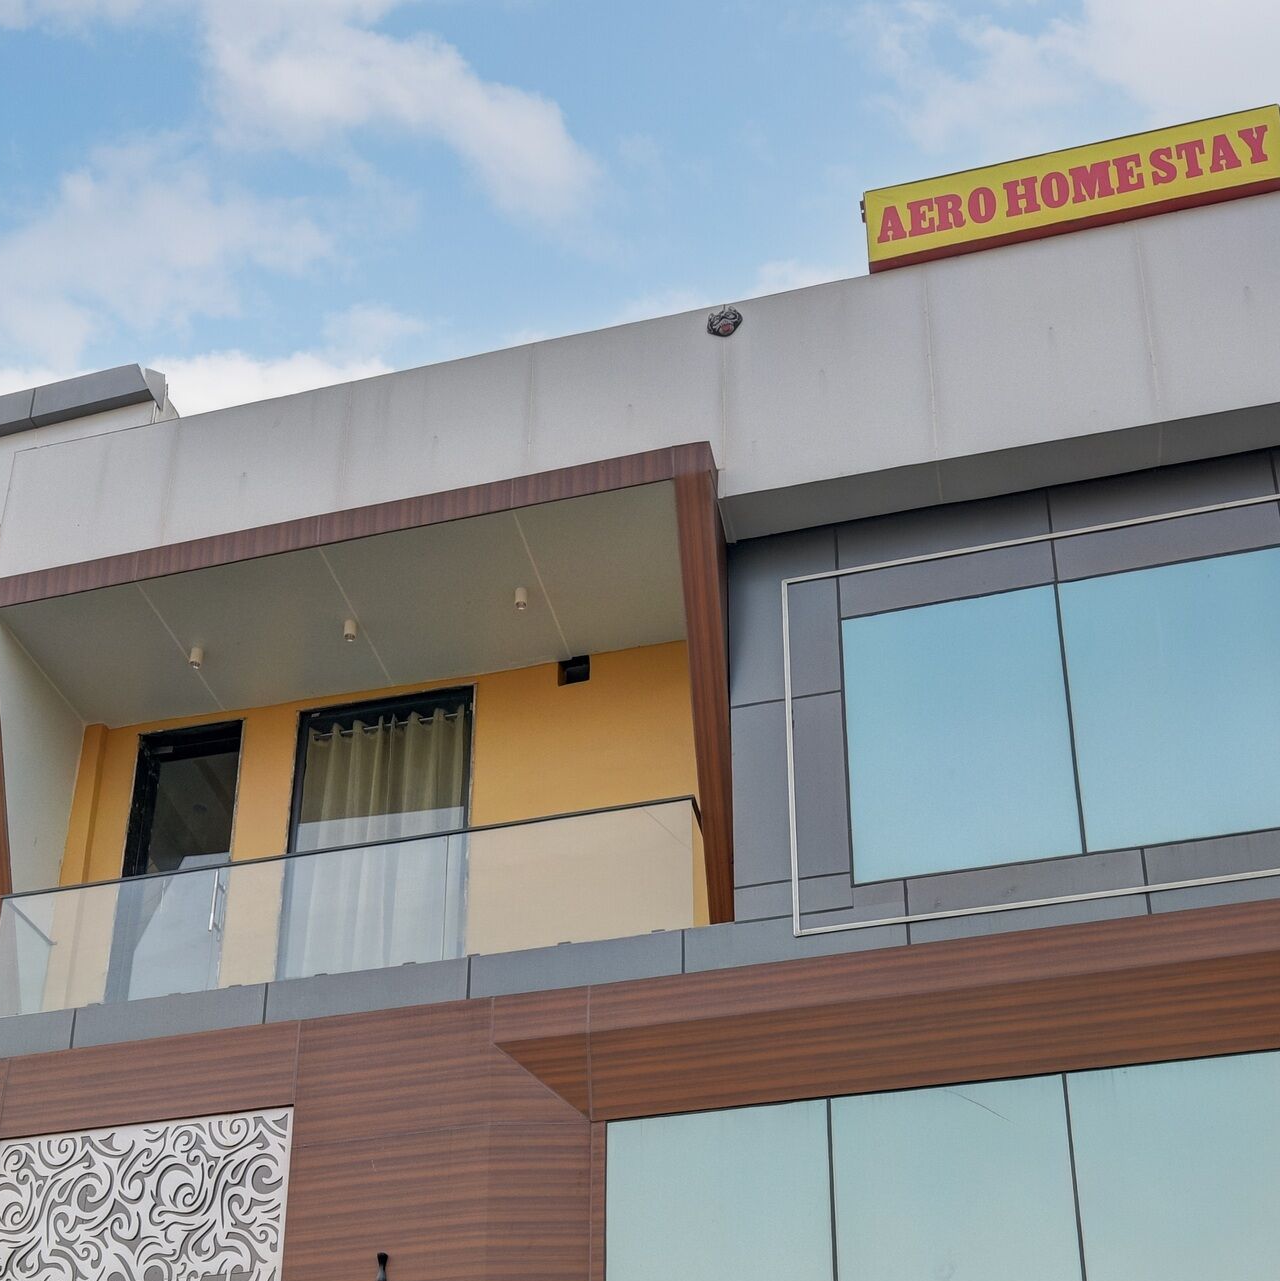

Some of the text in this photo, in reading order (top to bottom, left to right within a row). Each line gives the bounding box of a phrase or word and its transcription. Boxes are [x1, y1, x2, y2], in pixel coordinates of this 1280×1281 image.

[877, 124, 1269, 244] AERO HOME STAY
